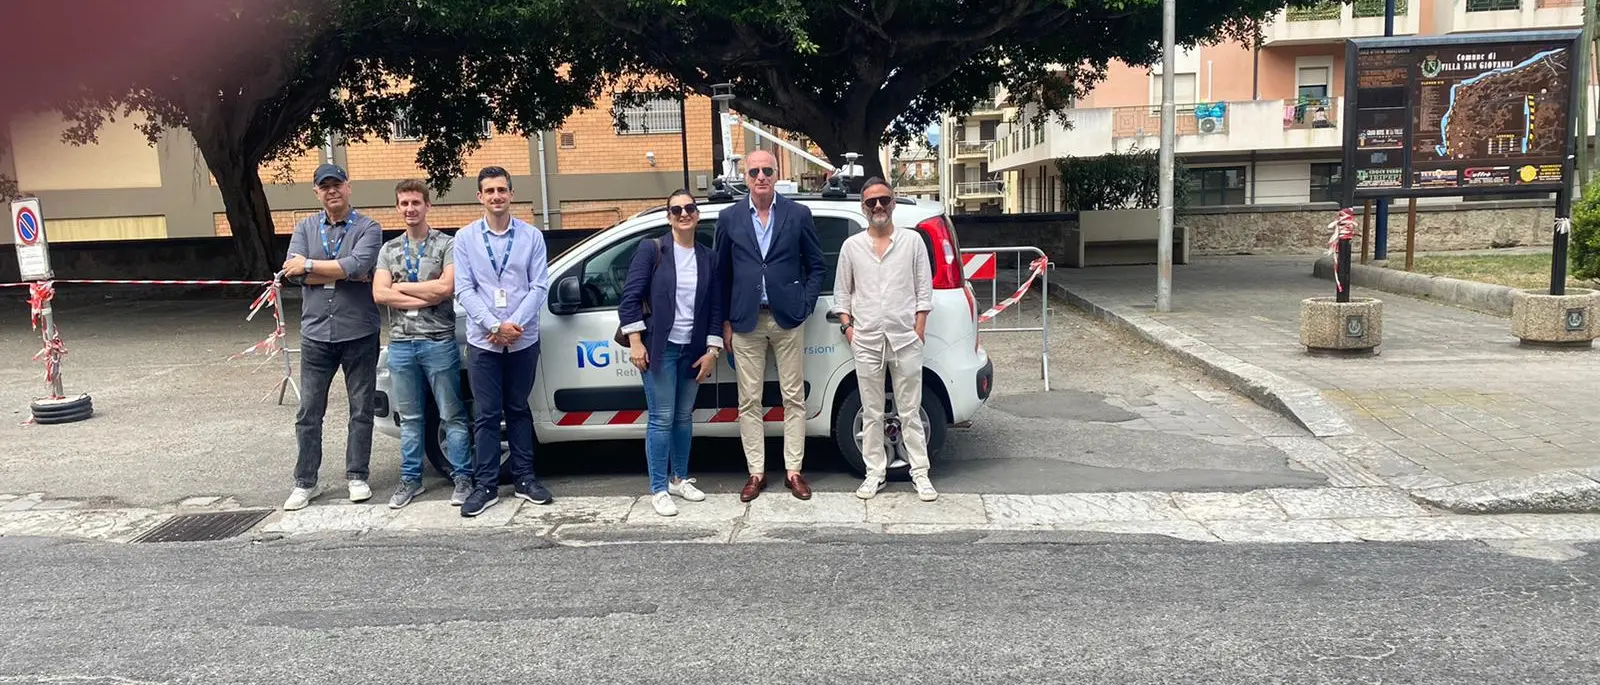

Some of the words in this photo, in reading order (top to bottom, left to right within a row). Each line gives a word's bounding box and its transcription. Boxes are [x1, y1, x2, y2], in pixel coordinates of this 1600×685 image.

[1456, 53, 1485, 61] Comune
[1488, 52, 1496, 60] di
[1441, 62, 1461, 71] VILLA
[1463, 62, 1477, 70] SAN
[1479, 60, 1514, 69] GIOVANNI
[577, 340, 610, 368] IG
[615, 349, 633, 364] It
[803, 344, 835, 354] rsioni
